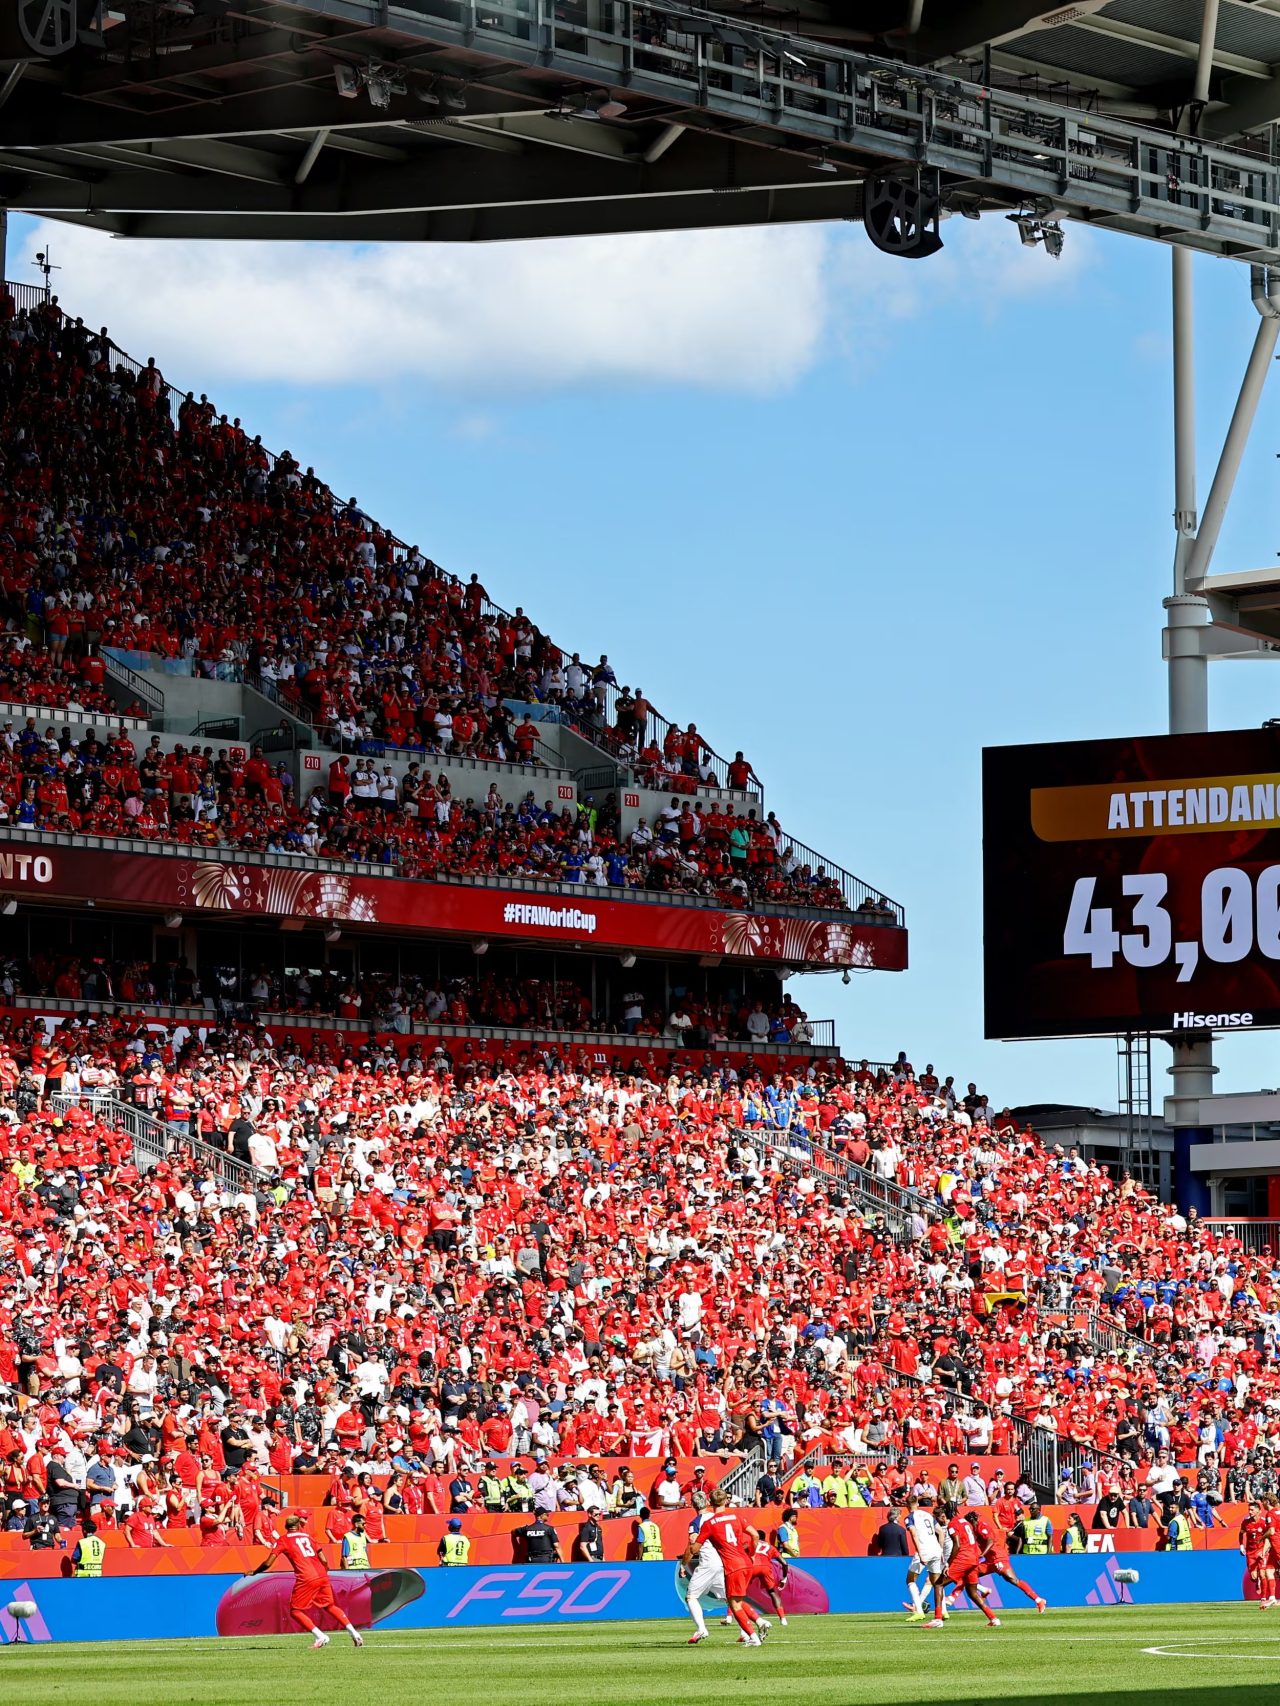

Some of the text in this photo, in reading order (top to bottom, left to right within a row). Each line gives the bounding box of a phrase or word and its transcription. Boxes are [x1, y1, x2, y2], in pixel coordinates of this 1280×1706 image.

[306, 756, 319, 769] 210
[559, 786, 572, 799] 210
[625, 795, 637, 807] 211
[503, 903, 597, 934] #FIFAWorldCup
[1173, 1012, 1253, 1029] Hisense
[725, 1523, 738, 1547] 4
[923, 1518, 934, 1536] 9
[295, 1537, 316, 1558] 13
